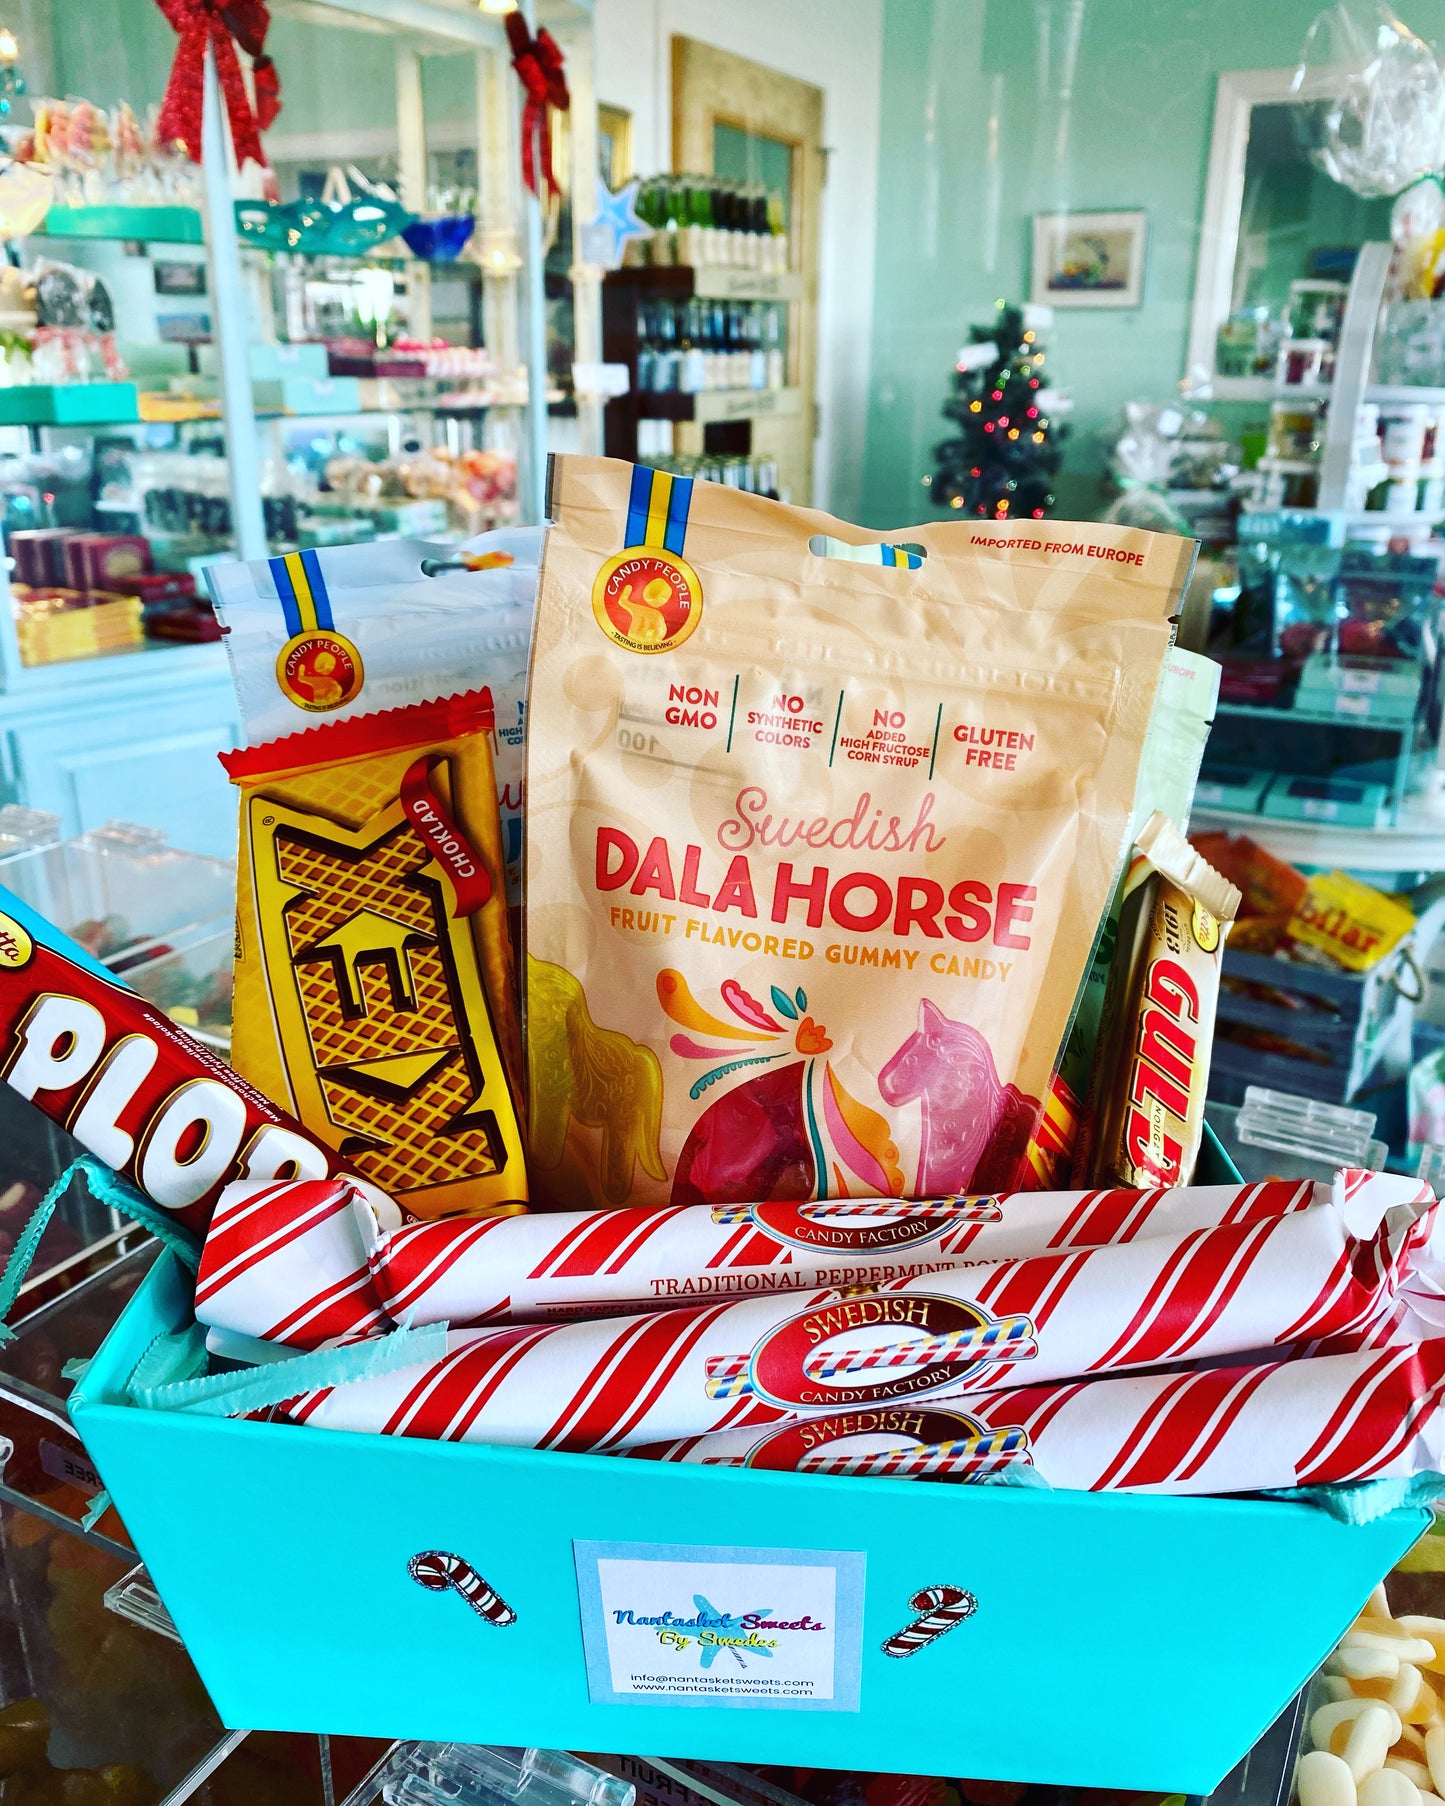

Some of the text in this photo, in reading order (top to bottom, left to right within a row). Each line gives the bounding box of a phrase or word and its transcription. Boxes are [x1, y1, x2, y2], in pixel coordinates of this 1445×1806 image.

[970, 535, 1145, 566] IMPORTED FROM EUROPE
[607, 560, 690, 609] CANDY PEOPLE
[613, 632, 637, 649] TASTING
[643, 640, 673, 651] BELIEVING
[286, 640, 353, 676] CANDY PEOPLE
[668, 683, 720, 708] NON
[772, 694, 804, 714] NO
[665, 706, 717, 730] GMO
[747, 711, 823, 735] SYNTHETIC
[873, 708, 906, 729] NO
[755, 730, 811, 749] COLORS
[840, 737, 930, 758] HIGH FRUCTOSE
[866, 729, 906, 743] ADDED
[953, 724, 1035, 752] GLUTEN
[847, 750, 919, 768] CORN SYRUP
[965, 748, 1017, 772] FREE
[717, 786, 946, 853] Swedish
[412, 799, 474, 878] CHOKLAD
[595, 826, 758, 919] DALA
[771, 862, 1037, 951] HORSE
[1163, 901, 1180, 955] 1913
[610, 906, 1014, 982] FRUIT FLAVORED GUMMY CANDY
[272, 821, 509, 1194] KEX
[1, 992, 402, 1227] PLOP
[794, 1219, 929, 1244] CANDY FACTORY
[650, 1273, 807, 1296] TRADITIONAL
[814, 1263, 956, 1286] PEPPERMINT
[547, 1306, 583, 1314] HARD
[803, 1299, 930, 1344] SWEDISH
[799, 1366, 952, 1404] CANDY FACTORY
[799, 1411, 927, 1449] SWEDISH
[612, 1609, 826, 1631] Nantasket Sweets
[656, 1629, 782, 1651] By Swedes
[630, 1674, 814, 1688] info@nantasketsweets.com
[632, 1683, 813, 1696] www.nantasketsweets.com
